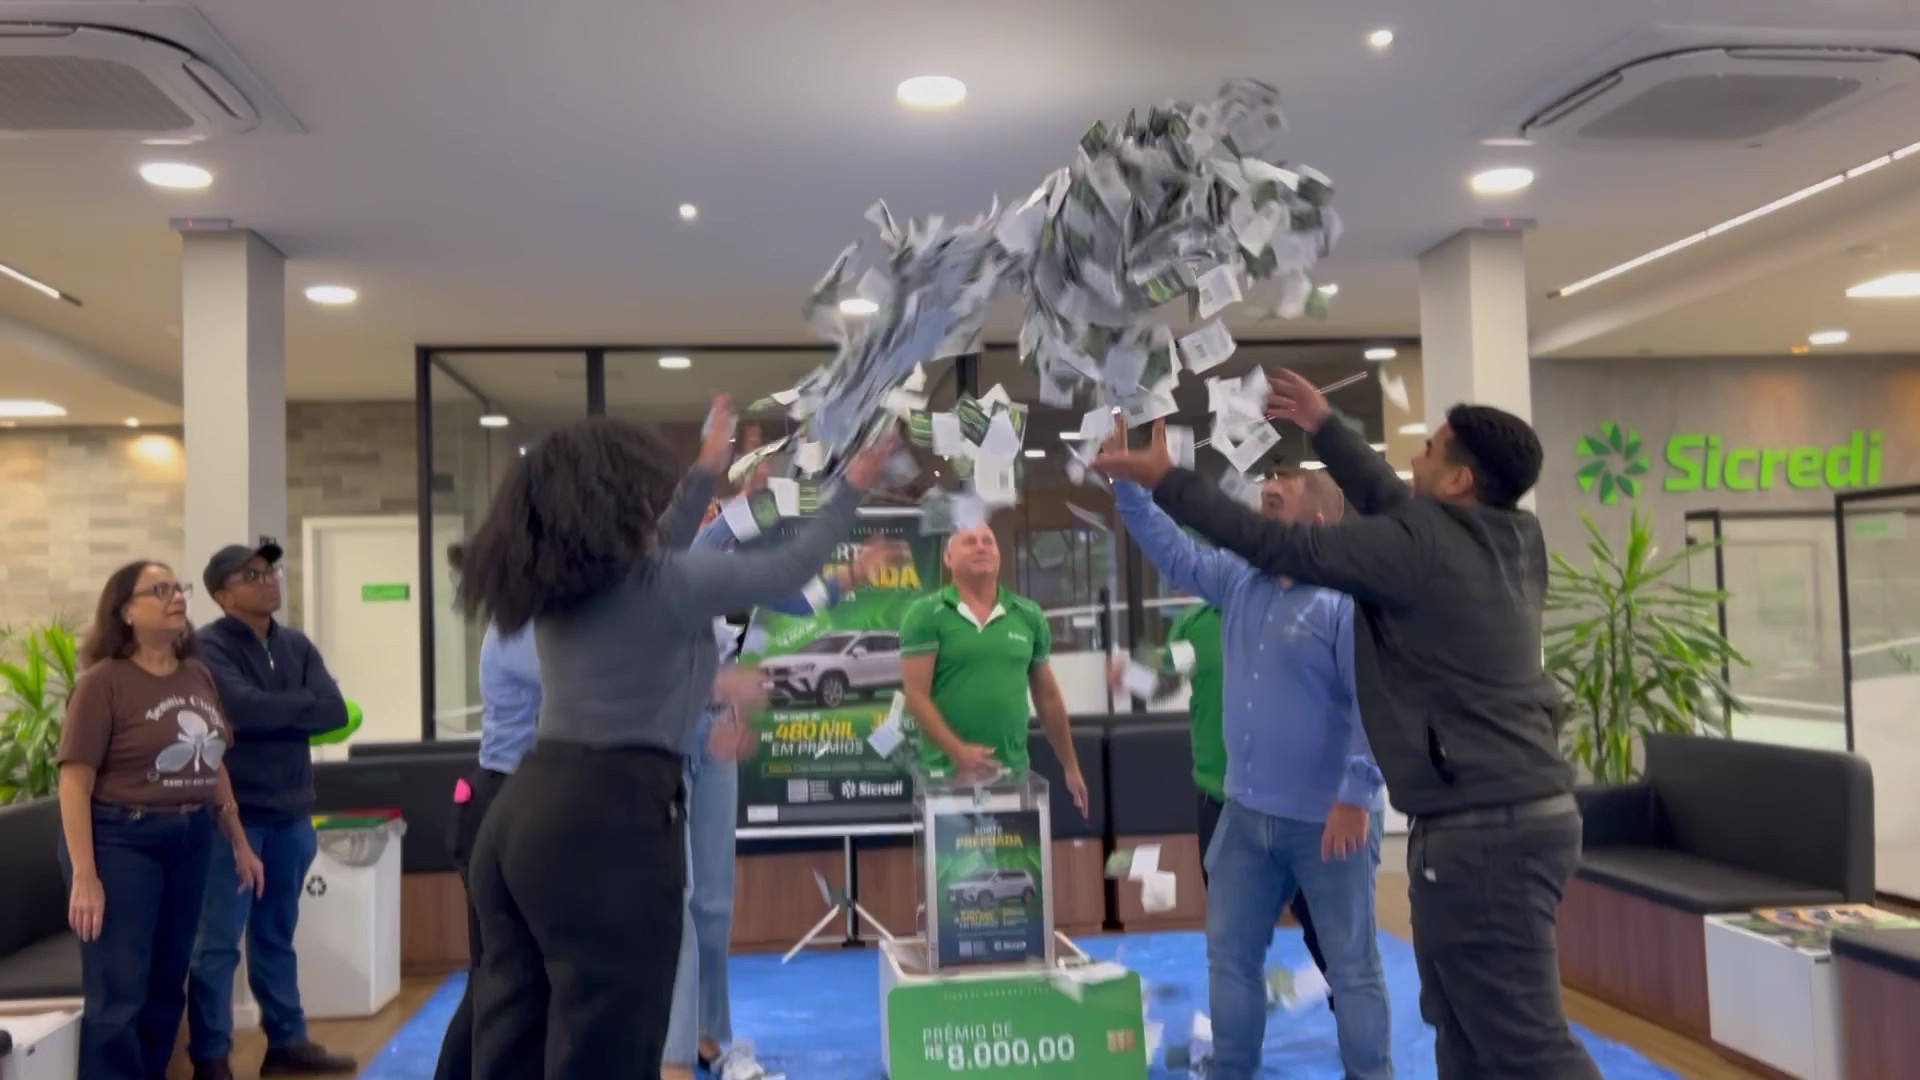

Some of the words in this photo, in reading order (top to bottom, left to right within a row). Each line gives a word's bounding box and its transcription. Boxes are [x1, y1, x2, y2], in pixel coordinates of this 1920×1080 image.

[1664, 429, 1882, 491] Sicredi
[776, 722, 816, 741] 480
[820, 719, 852, 740] MIL
[772, 743, 794, 756] EM
[859, 781, 903, 796] Sicredi
[992, 1020, 1013, 1038] DE
[948, 1034, 1075, 1070] 8.000,00
